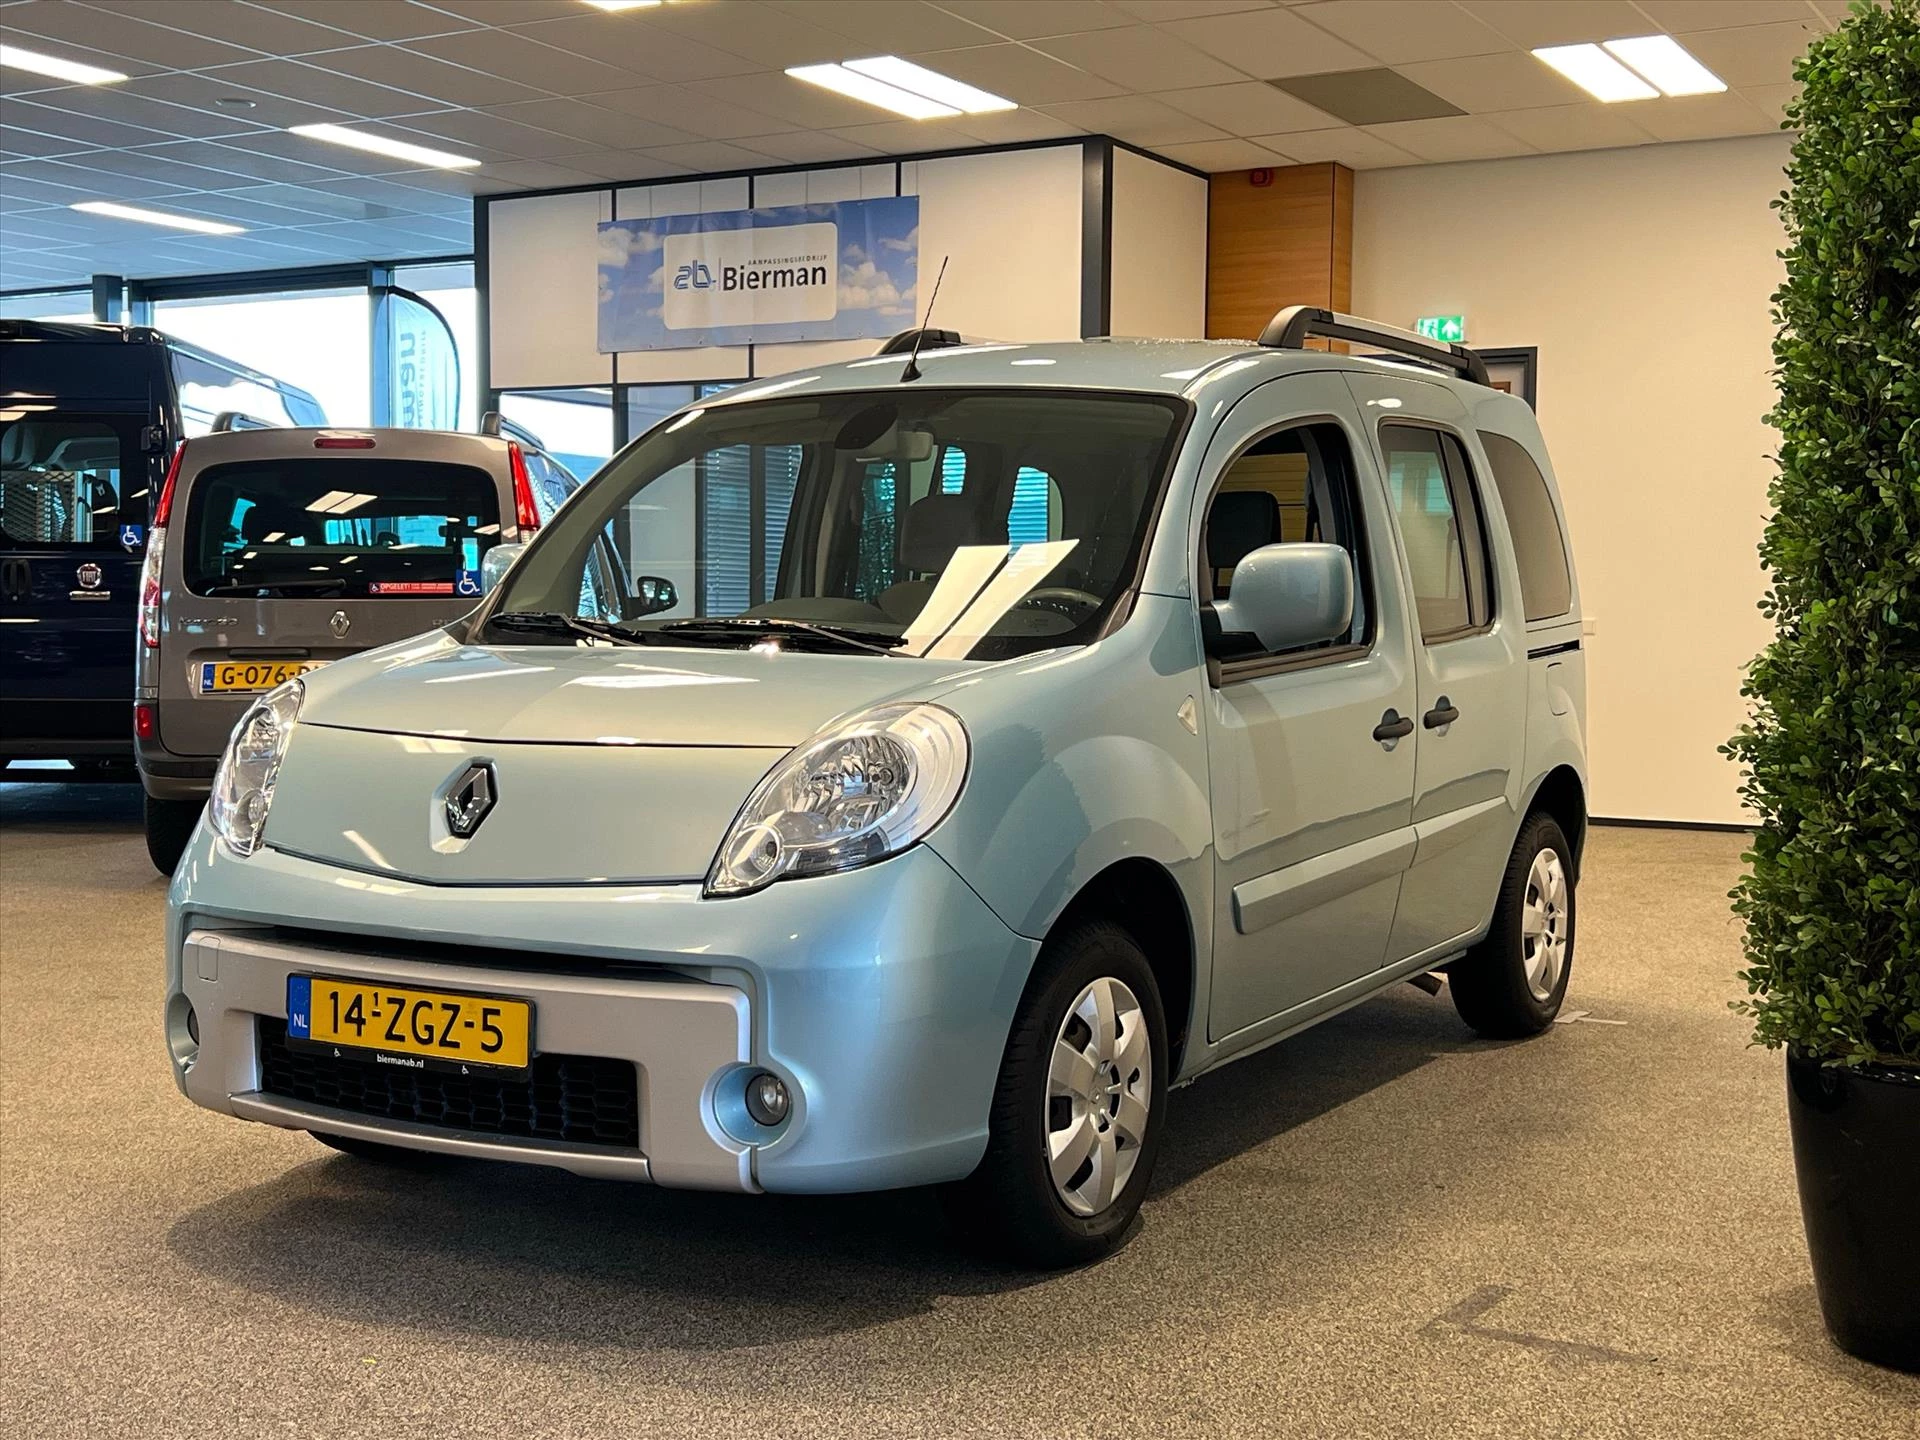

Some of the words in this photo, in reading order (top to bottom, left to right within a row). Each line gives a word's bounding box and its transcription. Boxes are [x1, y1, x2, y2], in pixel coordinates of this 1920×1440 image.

[748, 254, 828, 266] AANPASSINGSBEDRIJF
[722, 264, 828, 291] Bierman
[222, 665, 319, 685] G-076-
[293, 1013, 308, 1029] NL
[376, 1053, 424, 1069] biermanab.nl
